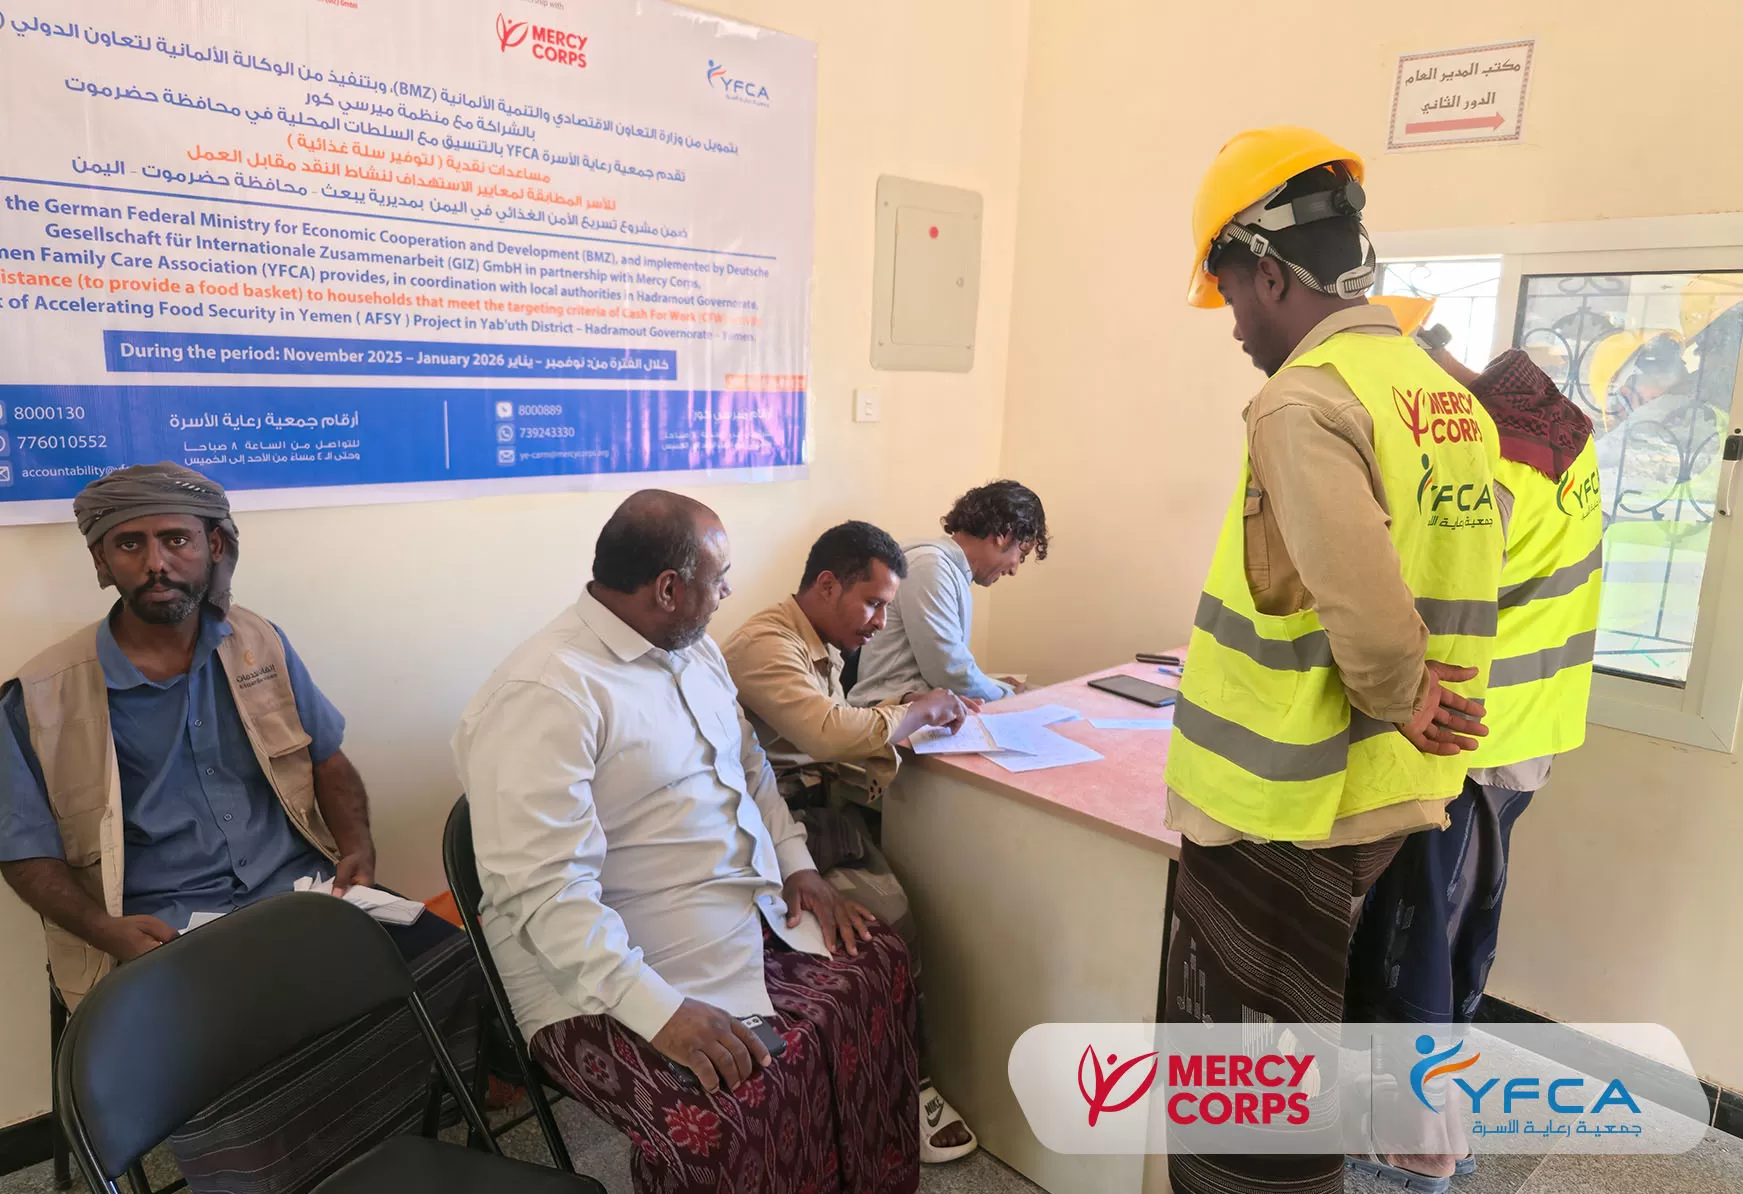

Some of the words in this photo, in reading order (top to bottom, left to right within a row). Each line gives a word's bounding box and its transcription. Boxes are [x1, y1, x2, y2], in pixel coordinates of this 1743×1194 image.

[10, 16, 78, 38] الدولي
[83, 26, 151, 50] لتعاون
[532, 25, 588, 51] MERCY
[155, 36, 228, 64] الألمانية
[532, 43, 587, 68] CORPS
[232, 50, 293, 76] الوكالة
[1439, 62, 1479, 82] المدير
[1481, 58, 1521, 78] مكتب
[297, 64, 323, 81] من
[327, 69, 386, 94] وبتنفيذ
[1405, 68, 1437, 86] العام
[64, 77, 158, 102] حضرموت
[720, 76, 769, 100] YFCA
[163, 88, 240, 116] محافظة
[304, 92, 334, 106] كور
[440, 87, 494, 110] الألمانية
[1421, 95, 1460, 114] الثاني
[1463, 92, 1496, 110] الدور
[244, 106, 272, 124] في
[338, 100, 393, 116] ميرسي
[397, 103, 449, 125] منظمة
[497, 98, 550, 122] والتنمية
[277, 106, 339, 130] المحلية
[452, 114, 473, 129] مع
[552, 113, 613, 131] الاقتصادي
[343, 121, 413, 141] السلطات
[476, 116, 535, 141] بالشراكة
[615, 124, 656, 139] التعاون
[658, 129, 683, 146] وزارة
[296, 133, 348, 154] غذائية
[417, 131, 438, 146] مع
[441, 135, 503, 157] بالتنسيق
[684, 137, 701, 148] من
[187, 144, 241, 163] العمل
[351, 141, 384, 159] سلة
[506, 143, 539, 160] YFCA
[542, 150, 579, 165] الأسرة
[71, 156, 124, 176] اليمن
[246, 152, 296, 171] مقابل
[301, 159, 340, 176] النقد
[446, 155, 485, 173] نقدية
[582, 154, 611, 173] رعاية
[613, 159, 654, 178] جمعية
[142, 165, 229, 185] حضرموت
[344, 164, 392, 182] لنشاط
[395, 172, 472, 192] الاستهداف
[487, 164, 550, 183] مساعدات
[234, 171, 307, 195] محافظة
[368, 188, 423, 210] بمديرية
[429, 197, 467, 214] اليمن
[526, 187, 582, 206] المطابقة
[470, 204, 492, 220] في
[495, 206, 544, 223] الغذائي
[547, 212, 578, 225] الأمن
[580, 215, 617, 230] تسريع
[619, 220, 658, 235] مشروع
[5, 194, 39, 212] the
[44, 198, 121, 218] German
[127, 205, 194, 225] Federal
[200, 212, 270, 235] Ministry
[274, 219, 297, 234] for
[302, 222, 375, 241] Economic
[379, 230, 465, 249] Cooperation
[469, 240, 493, 252] and
[497, 241, 579, 260] Development
[620, 255, 641, 266] and
[643, 256, 709, 272] implemented
[712, 262, 724, 276] by
[726, 263, 768, 277] Deutsche
[45, 223, 161, 245] Gesellschaft
[165, 231, 191, 247] für
[196, 235, 315, 257] Internationale
[319, 245, 443, 268] Zusammenarbeit
[447, 256, 479, 272] (GIZ)
[482, 259, 521, 274] GmbH
[525, 263, 536, 275] in
[539, 267, 607, 282] partnership
[609, 271, 633, 282] with
[40, 246, 105, 268] Family
[110, 252, 152, 268] Care
[158, 255, 256, 275] Association
[262, 262, 314, 281] (YFCA)
[319, 269, 389, 285] provides,
[393, 272, 406, 284] in
[410, 275, 496, 291] coordination
[499, 281, 526, 293] with
[530, 282, 557, 295] local
[560, 286, 621, 300] authorities
[636, 290, 694, 305] Hadramout
[77, 273, 103, 289] (to
[109, 277, 180, 293] provide
[184, 283, 194, 293] a
[198, 280, 238, 296] food
[243, 282, 302, 301] basket)
[306, 288, 322, 300] to
[327, 287, 412, 306] households
[415, 294, 443, 307] that
[447, 299, 480, 309] meet
[483, 298, 504, 311] the
[507, 301, 564, 317] targeting
[565, 306, 606, 317] criteria
[608, 306, 620, 317] of
[8, 294, 28, 309] of
[34, 295, 153, 318] Accelerating
[159, 301, 203, 316] Food
[208, 303, 275, 323] Security
[280, 307, 294, 320] in
[298, 308, 351, 323] Yemen
[364, 311, 400, 325] AFSY
[413, 314, 461, 330] Project
[464, 316, 476, 328] in
[479, 317, 528, 331] Yab'uth
[531, 320, 572, 333] District
[584, 323, 646, 336] Hadramout
[120, 342, 183, 361] During
[187, 343, 216, 359] the
[220, 345, 279, 362] period:
[283, 347, 364, 362] November
[367, 350, 402, 363] 2025
[416, 351, 469, 368] January
[472, 353, 504, 365] 2026
[14, 406, 84, 419] 8000130
[517, 404, 562, 415] 8000889
[169, 412, 218, 430] الأسرة
[221, 412, 260, 430] رعاية
[264, 412, 318, 429] جمعية
[321, 410, 358, 428] أرقام
[16, 434, 106, 448] 776010552
[519, 426, 574, 438] 739243330
[245, 441, 286, 450] الساعة
[291, 441, 310, 450] من
[314, 440, 360, 450] للتواصل
[184, 455, 227, 466] الخميس
[229, 454, 245, 465] إلى
[247, 454, 270, 463] الأحد
[272, 454, 287, 464] من
